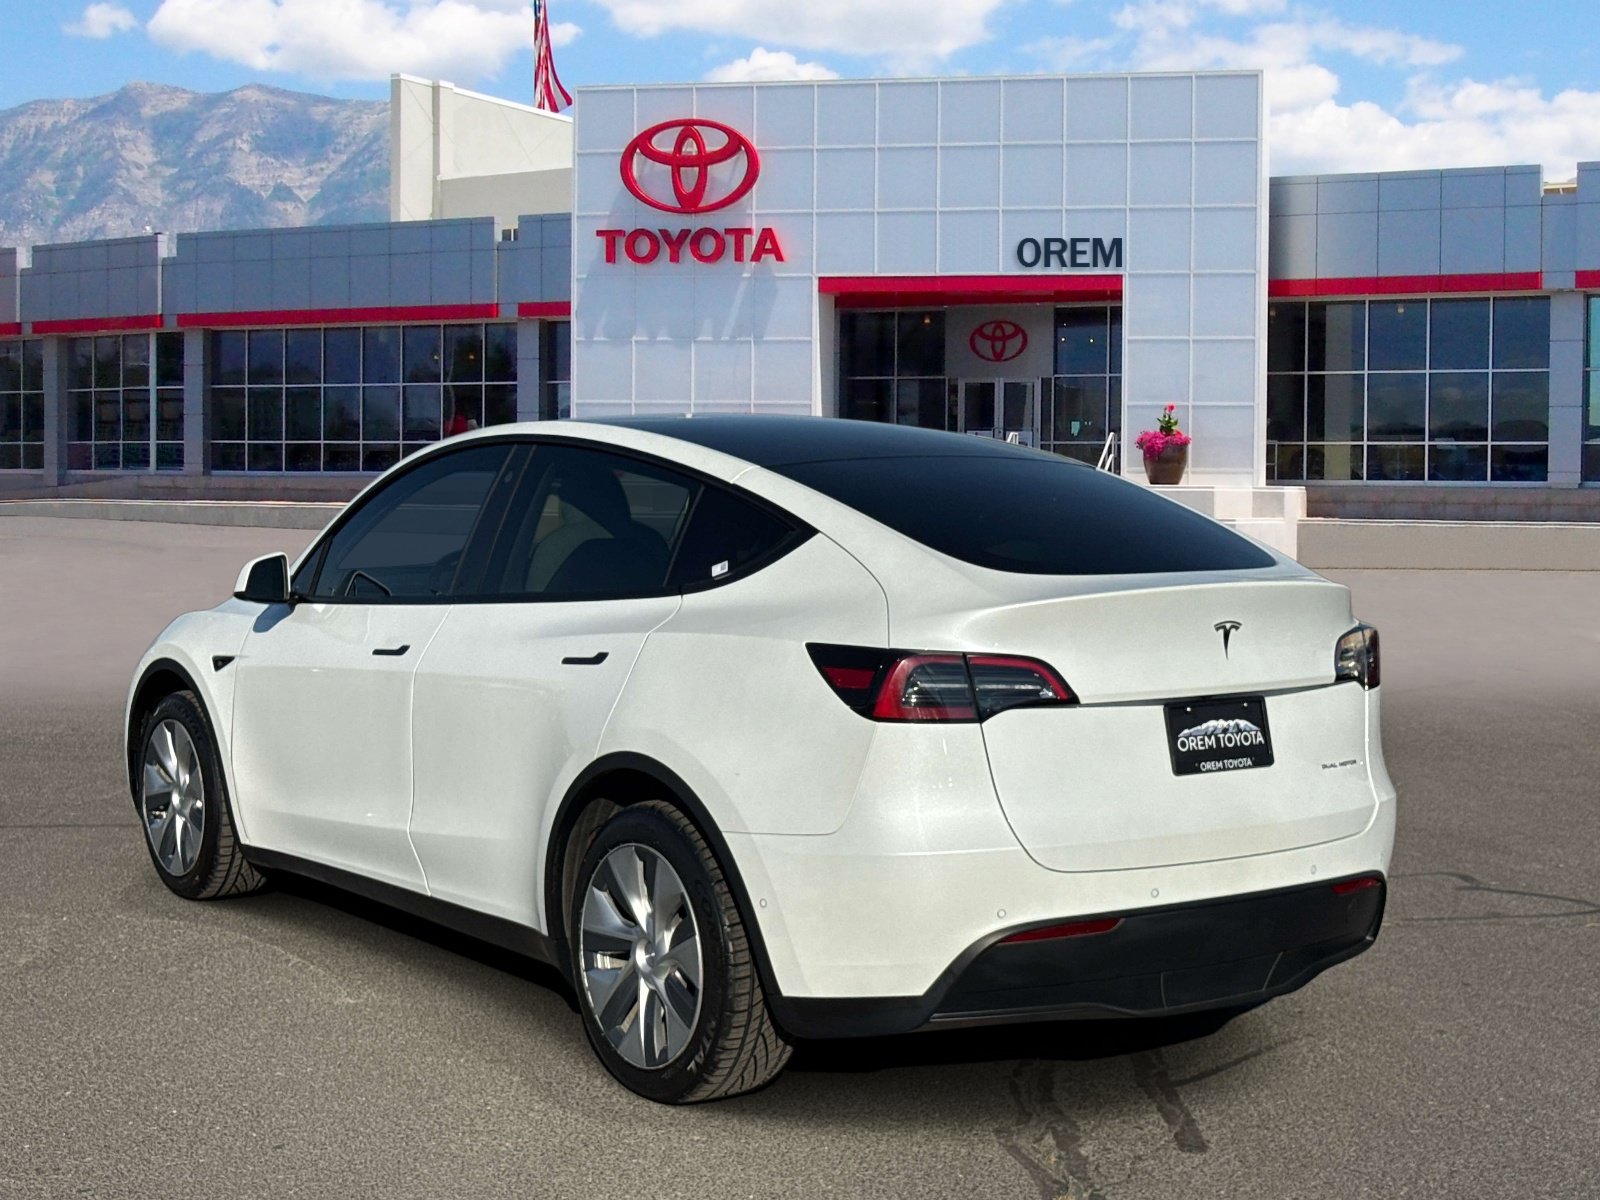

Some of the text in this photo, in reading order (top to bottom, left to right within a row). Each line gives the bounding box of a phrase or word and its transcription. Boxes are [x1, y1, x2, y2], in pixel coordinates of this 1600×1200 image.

[596, 227, 784, 264] TOYOTA
[1017, 237, 1122, 268] OREM
[1178, 731, 1264, 752] OREM TOYOTA
[1200, 757, 1252, 772] OREM TOYOTA
